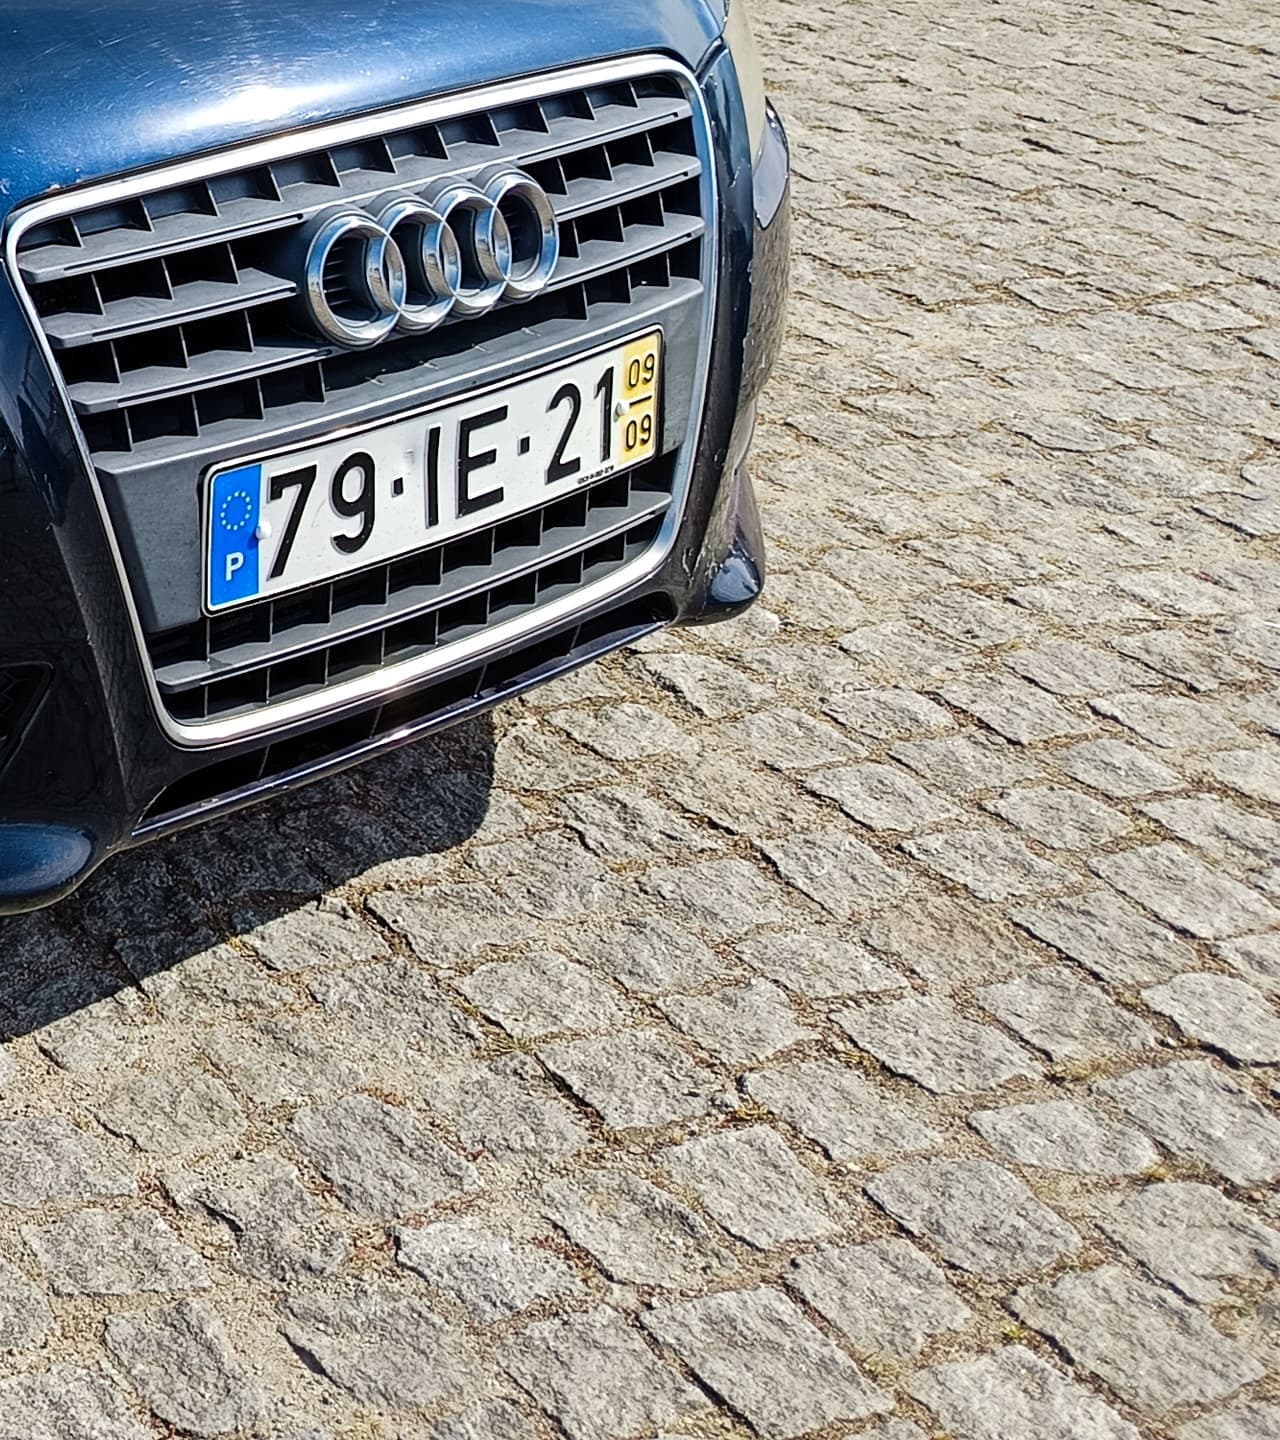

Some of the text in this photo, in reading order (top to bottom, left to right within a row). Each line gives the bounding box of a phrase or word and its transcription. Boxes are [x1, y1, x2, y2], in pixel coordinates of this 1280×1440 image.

[627, 353, 655, 389] 09
[625, 413, 652, 451] 09
[226, 552, 244, 582] P
